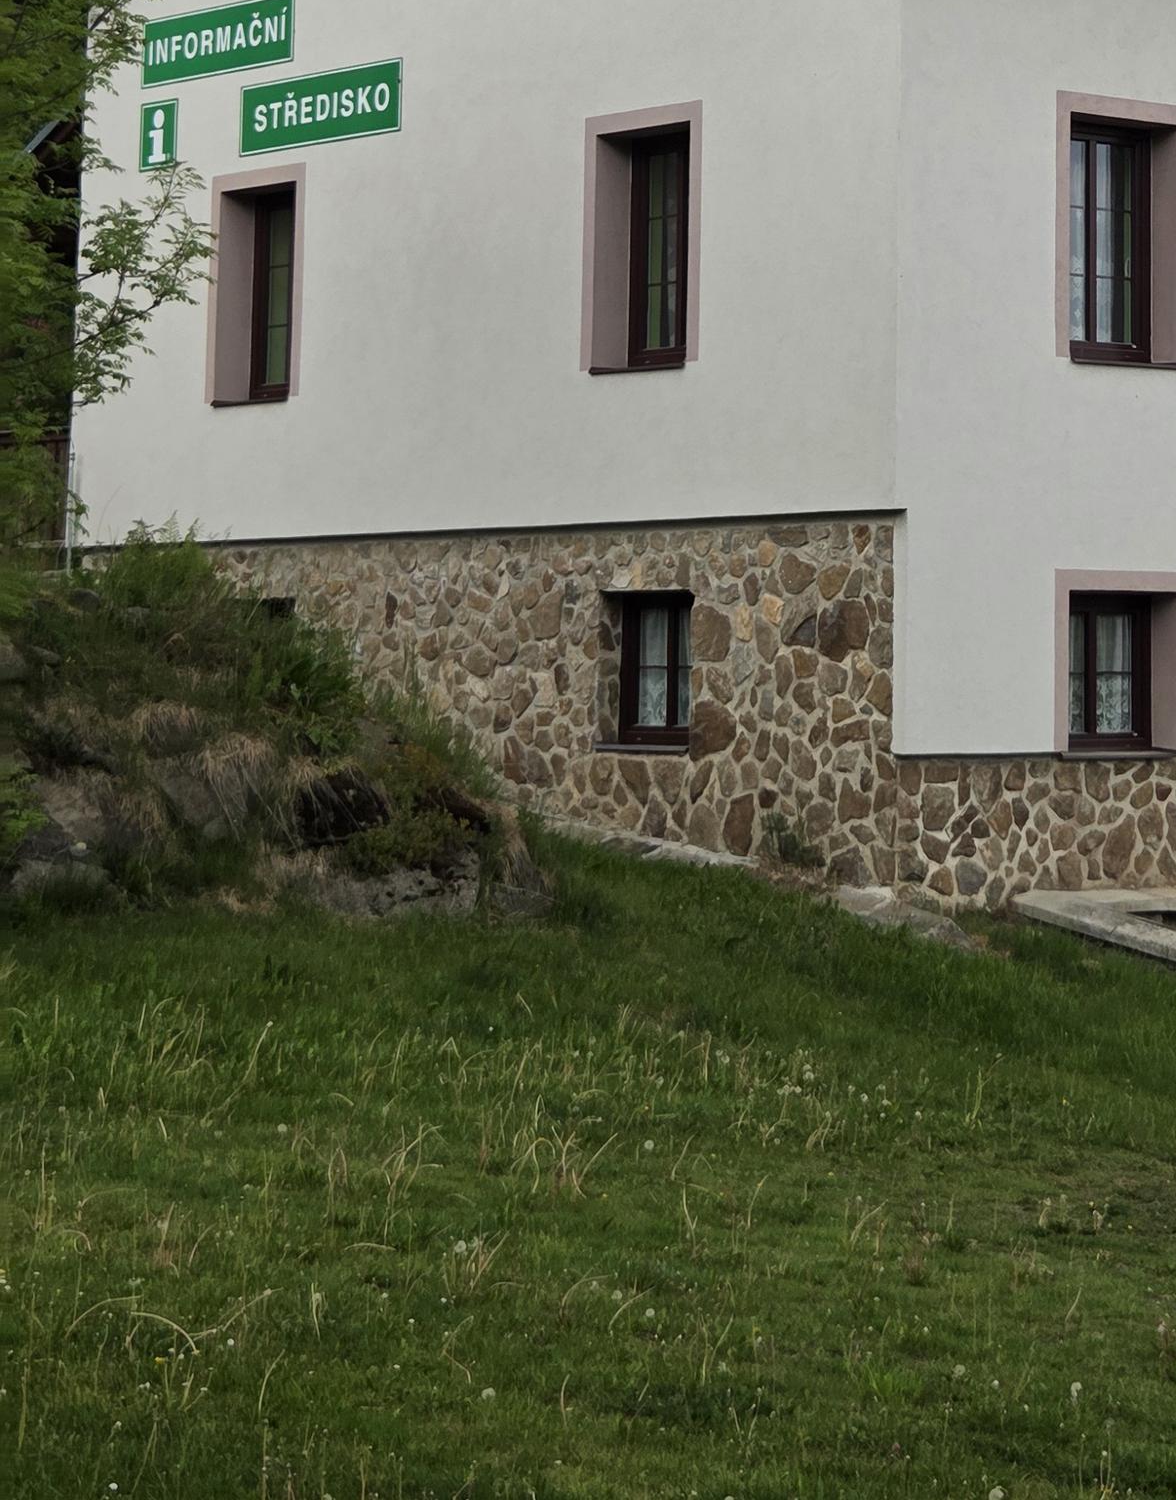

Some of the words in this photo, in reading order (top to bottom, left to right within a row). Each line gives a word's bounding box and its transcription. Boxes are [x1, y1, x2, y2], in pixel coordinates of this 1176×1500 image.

[148, 6, 288, 66] INFORMAČNÍ
[254, 82, 390, 132] STŘEDISKO
[148, 108, 166, 164] i
